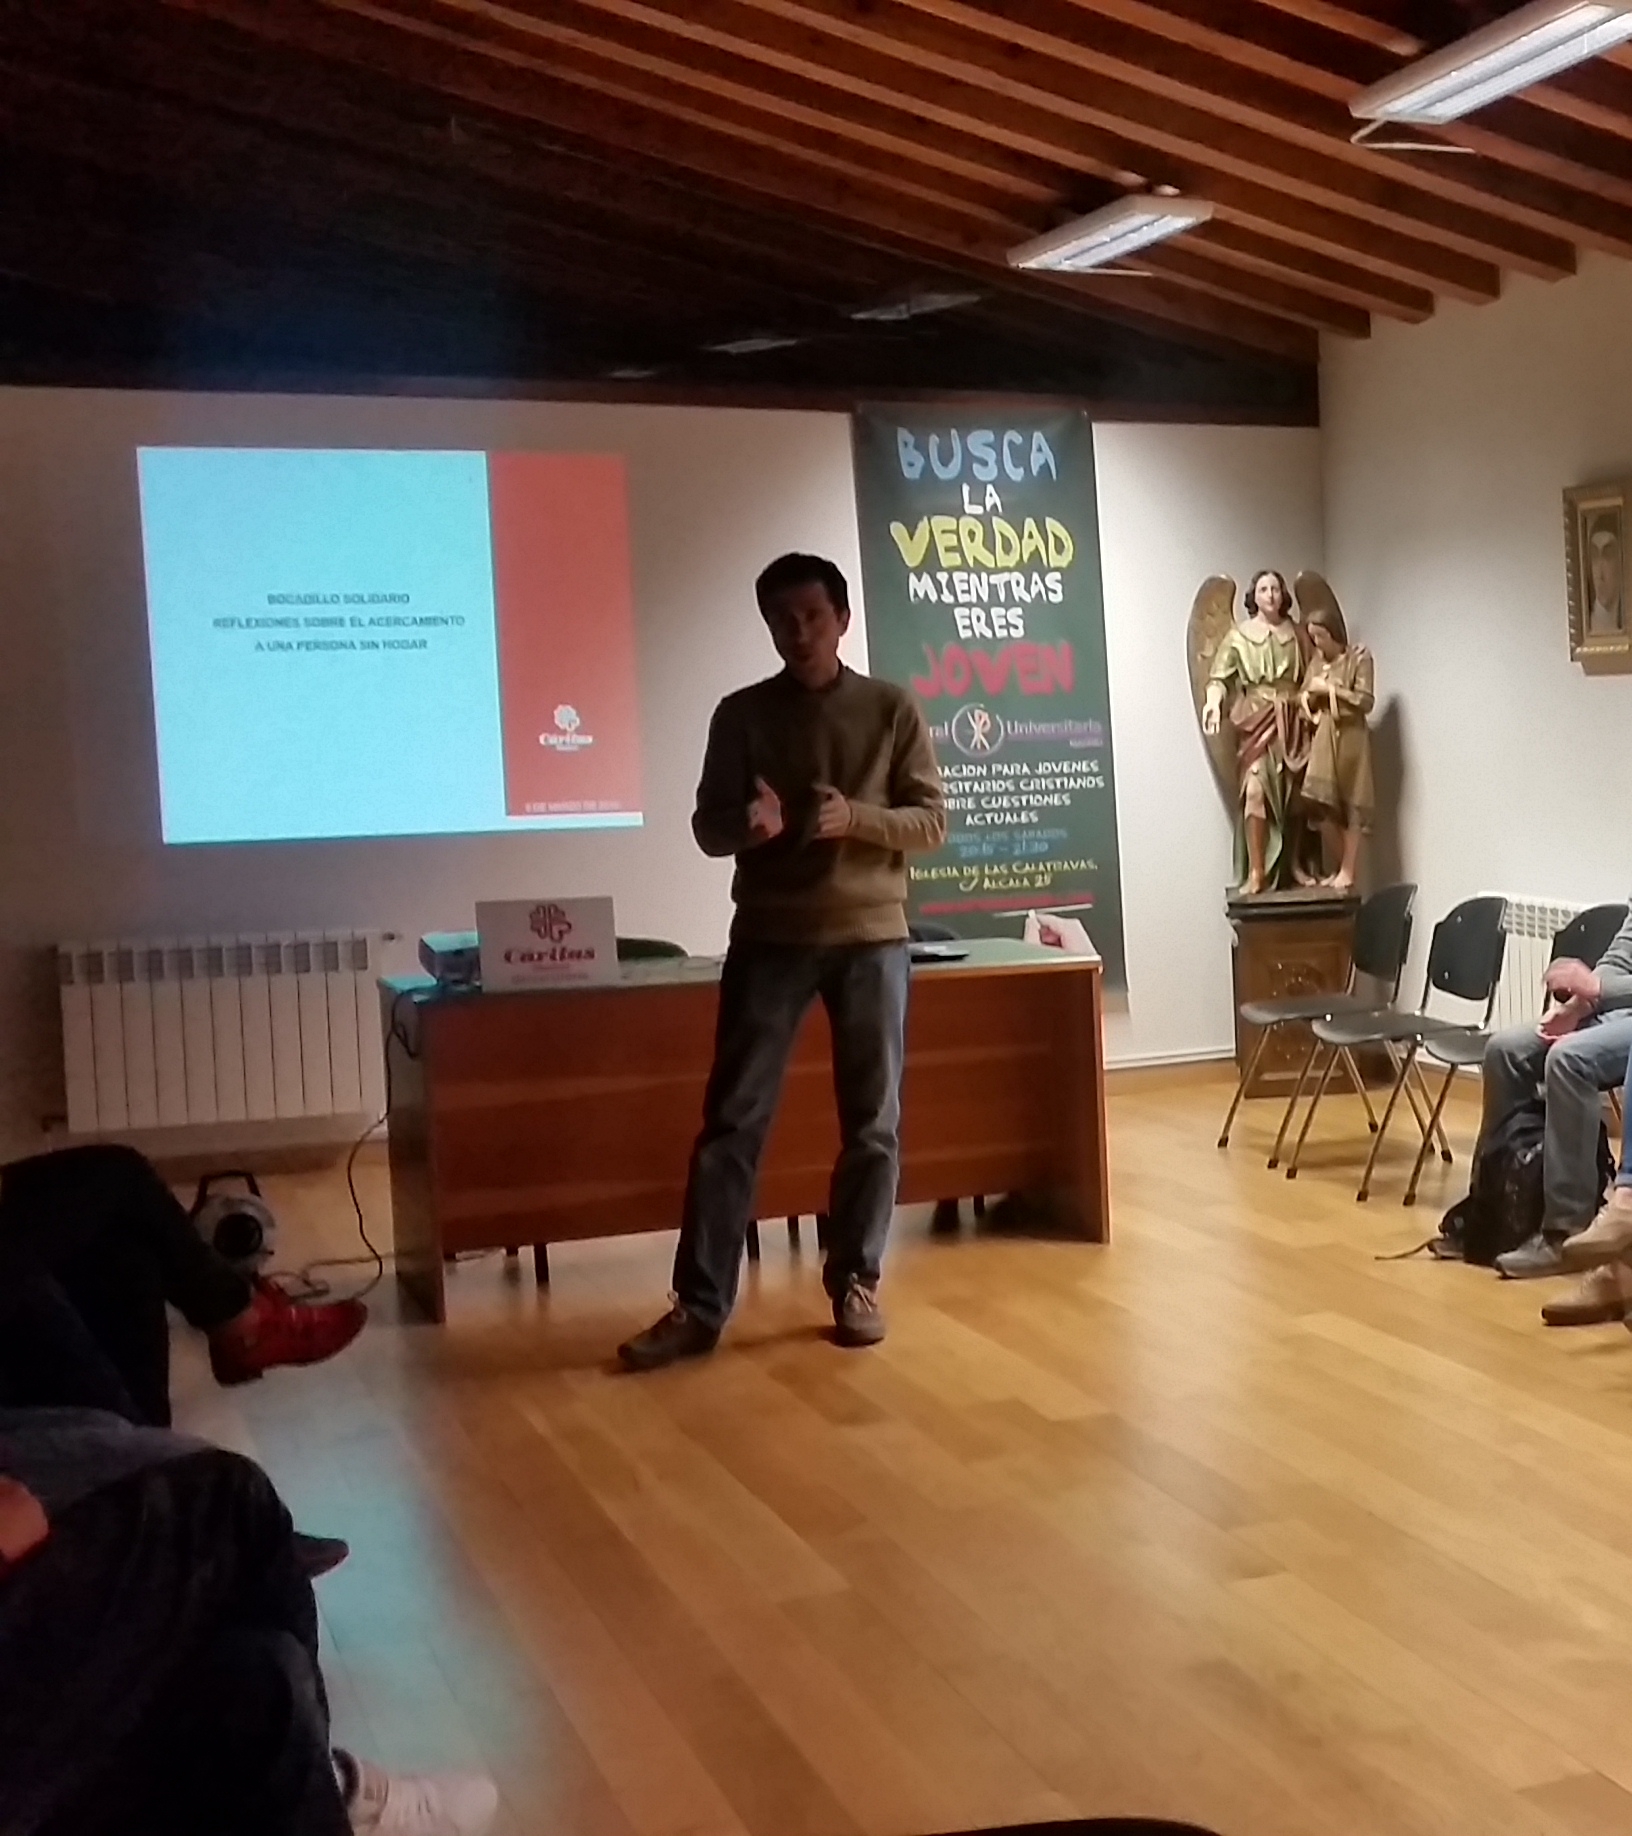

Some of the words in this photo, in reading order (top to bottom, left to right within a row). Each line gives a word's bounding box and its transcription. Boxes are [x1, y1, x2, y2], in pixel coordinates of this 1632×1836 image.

[897, 427, 1057, 482] BUSCA
[961, 482, 1002, 514] LA
[890, 515, 1074, 568] VERDAD
[908, 571, 1063, 603] MIENTRAS
[267, 593, 340, 605] BOCADILLO
[343, 592, 410, 604] SOLIDARIO
[213, 617, 300, 629] REFLEXIONES
[303, 616, 346, 628] SOBRE
[349, 616, 364, 628] EL
[367, 615, 466, 627] ACERCAMIENTO
[953, 607, 1025, 639] ERES
[254, 641, 265, 651] A
[267, 640, 294, 651] UNA
[297, 639, 357, 651] PERSONA
[360, 639, 380, 650] SIN
[382, 638, 428, 650] HOGAR
[910, 640, 1076, 699] JOVEN
[991, 762, 1031, 776] PARA
[1034, 760, 1100, 775] JOVENES
[1019, 776, 1105, 792] CRISTIANOS
[981, 792, 1072, 809] CUESTIONES
[965, 810, 1039, 826] ACTUALES
[910, 866, 960, 880] IGLESIA
[963, 865, 979, 878] DE
[984, 863, 1008, 876] LAS
